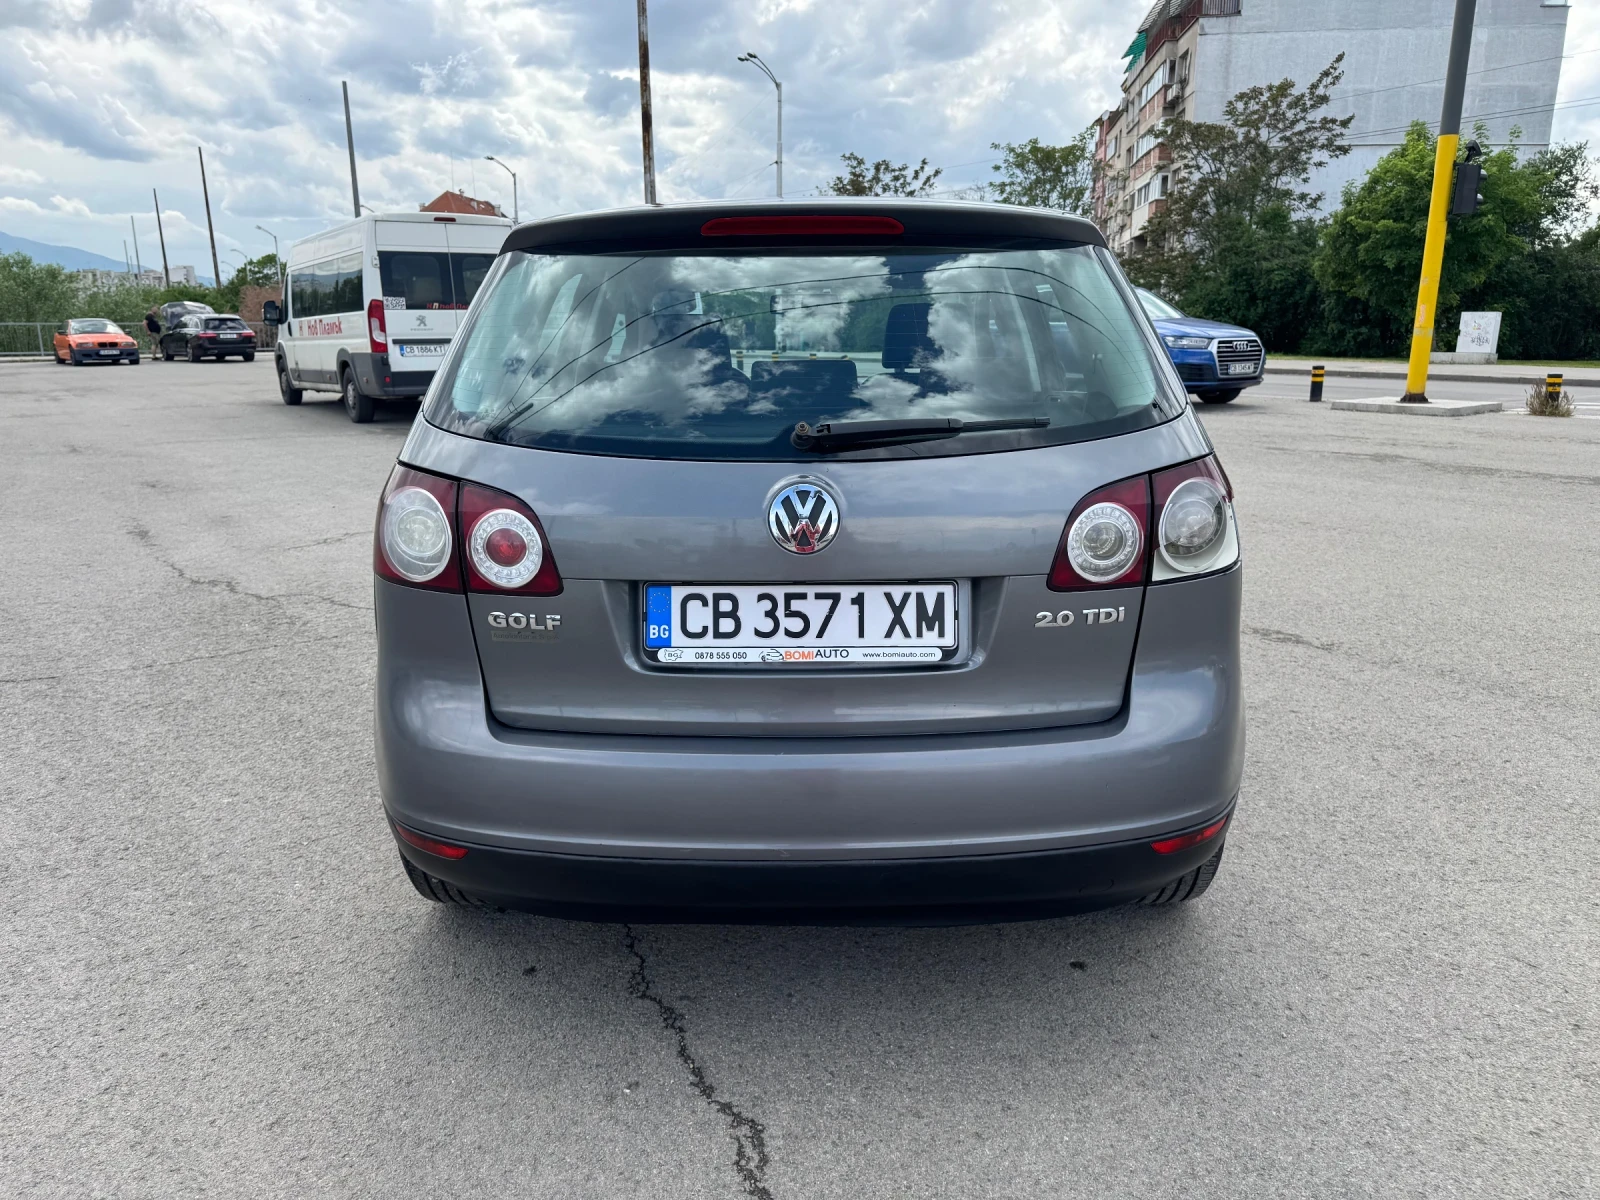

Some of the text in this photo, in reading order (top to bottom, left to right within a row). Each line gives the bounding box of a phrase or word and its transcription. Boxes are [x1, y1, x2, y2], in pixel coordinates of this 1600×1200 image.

[487, 611, 561, 630] GOLF
[680, 592, 945, 639] CB 3571 XM
[649, 625, 669, 638] BG
[694, 651, 748, 659] 0878 555 050
